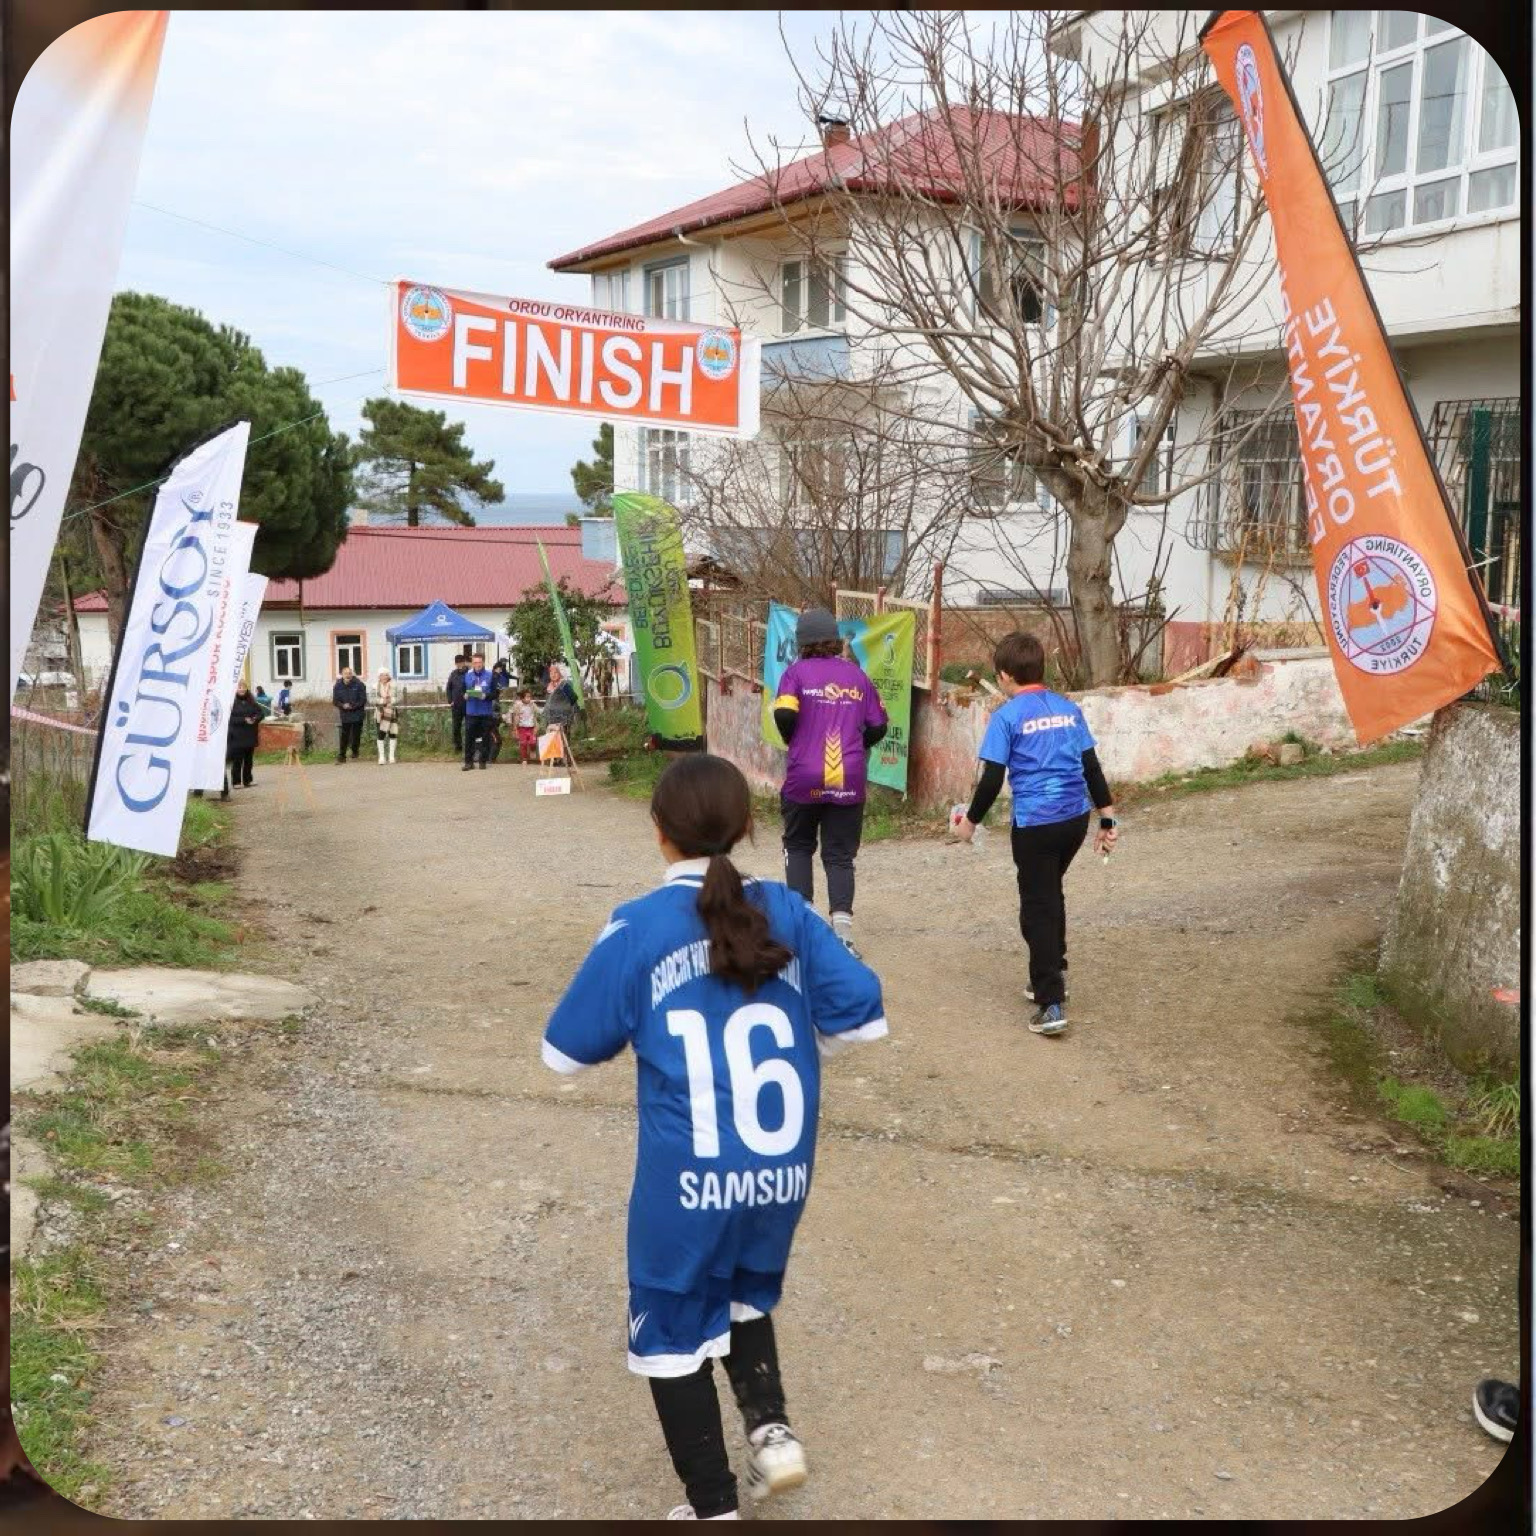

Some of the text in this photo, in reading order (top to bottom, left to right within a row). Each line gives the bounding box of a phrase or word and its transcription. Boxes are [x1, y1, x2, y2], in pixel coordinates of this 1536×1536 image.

[452, 312, 694, 415] FINISH
[508, 300, 645, 333] ORDU ORYANTİRİNG
[207, 500, 235, 599] SINCE 1933
[115, 497, 217, 814] GÜRSOY
[666, 1002, 806, 1159] 16
[679, 1163, 807, 1210] SAMSUN
